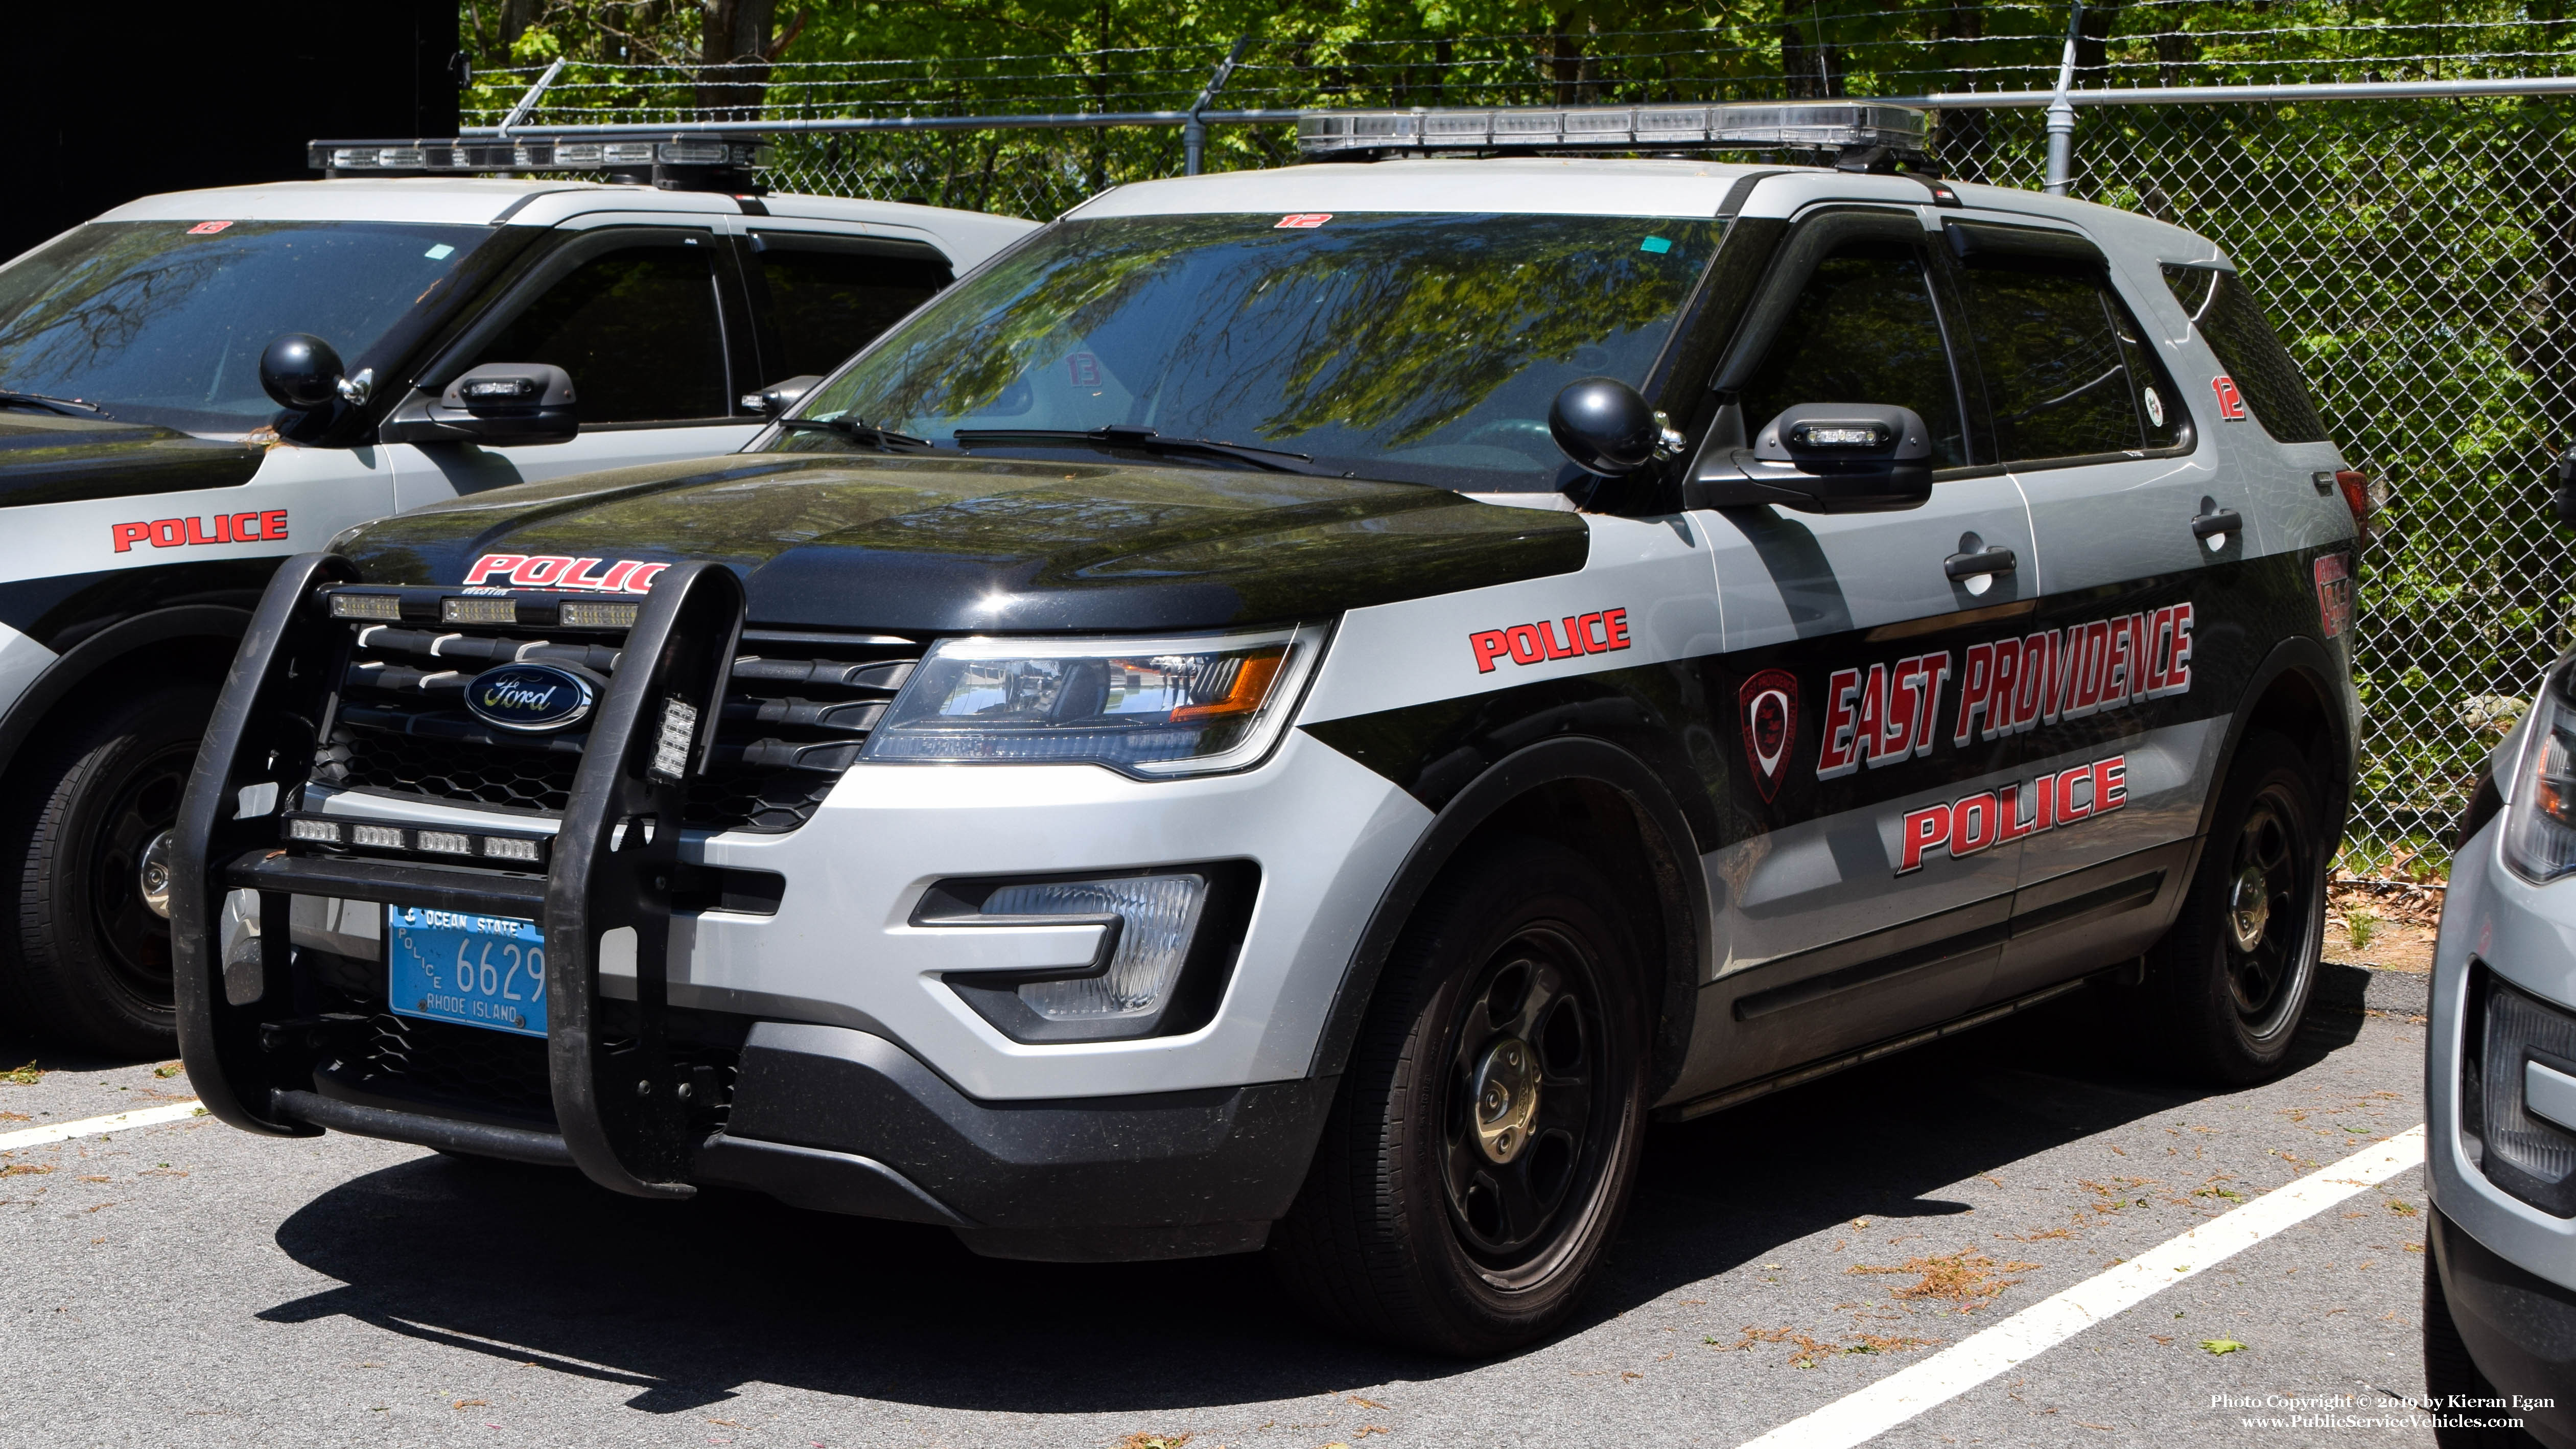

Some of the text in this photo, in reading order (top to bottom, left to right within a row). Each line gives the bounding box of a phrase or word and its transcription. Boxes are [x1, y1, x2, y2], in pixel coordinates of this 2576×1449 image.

[186, 221, 233, 234] 13
[1274, 213, 1333, 228] 12
[1064, 352, 1102, 387] 13
[2211, 376, 2246, 422] 12
[112, 509, 288, 553] POLICE
[463, 554, 671, 594] POLIC
[1469, 607, 1631, 674] POLICE
[484, 673, 557, 711] Ford
[1816, 650, 1952, 781] EAST
[1954, 602, 2193, 747] PROVIDENCE
[1894, 754, 2127, 875] POLICE
[426, 909, 519, 938] OCEAN STATE
[398, 927, 442, 989] POLICE
[457, 938, 546, 1002] 6629
[427, 993, 517, 1022] RHODE ISLAND
